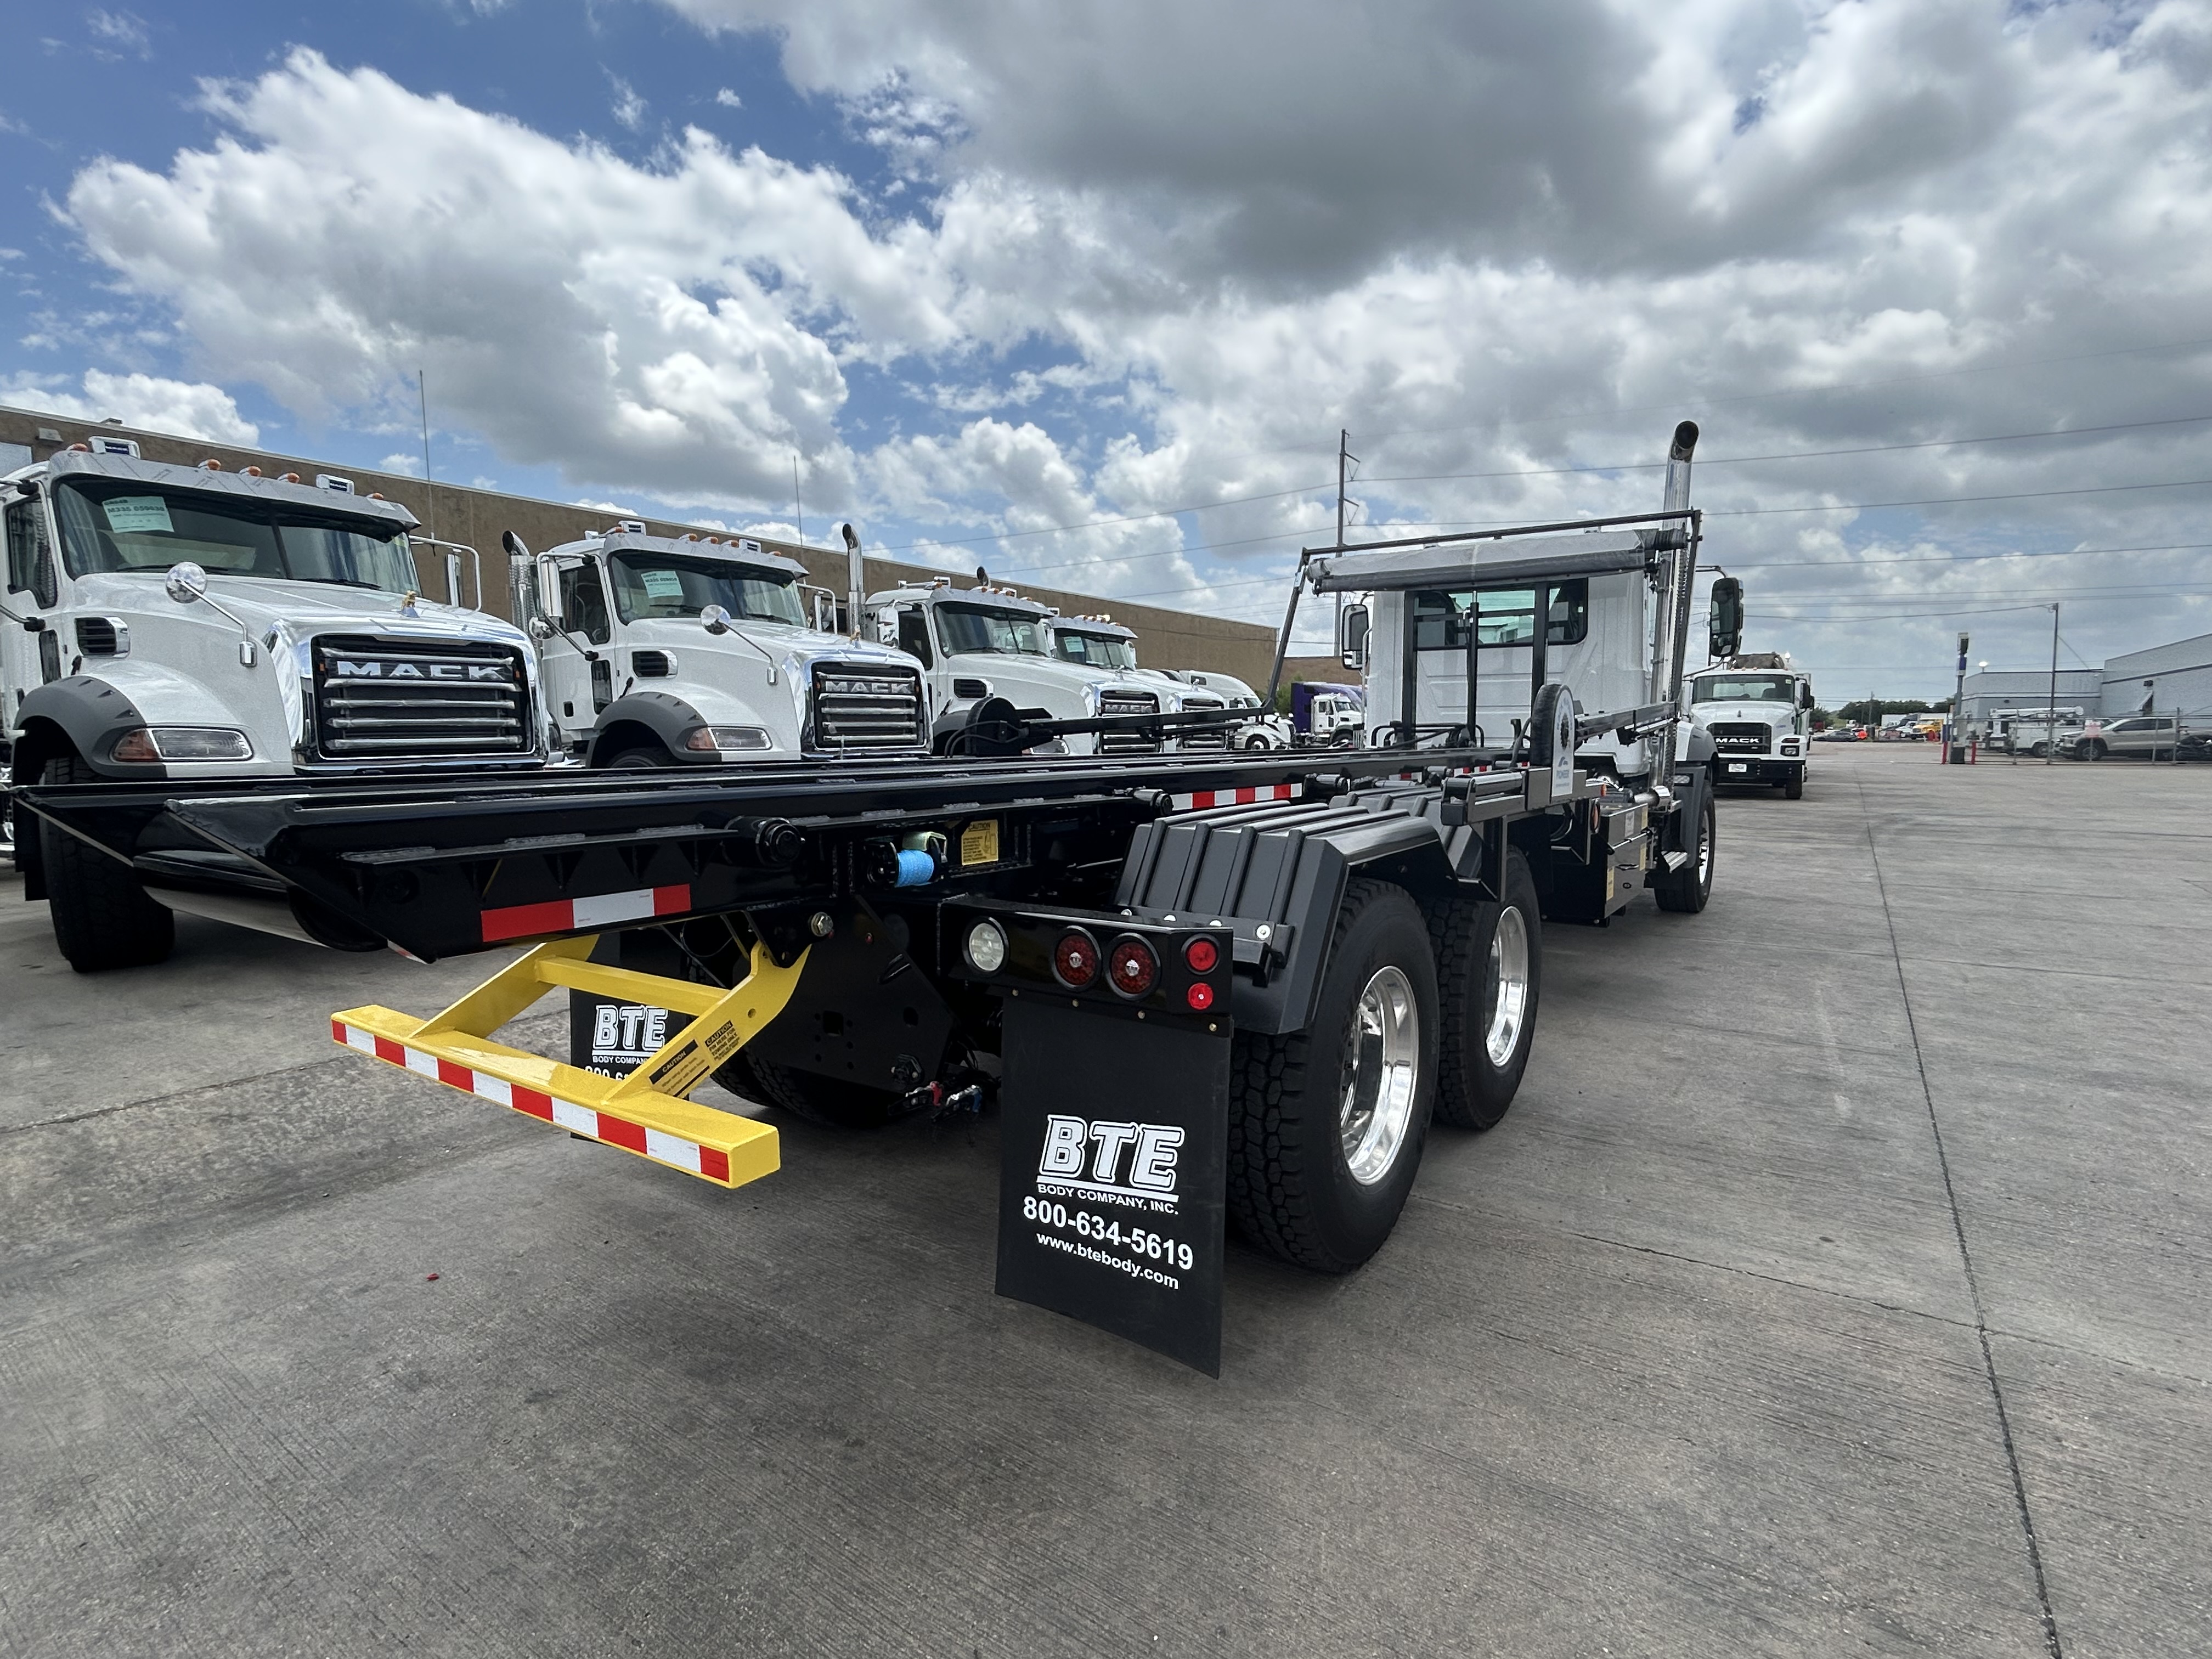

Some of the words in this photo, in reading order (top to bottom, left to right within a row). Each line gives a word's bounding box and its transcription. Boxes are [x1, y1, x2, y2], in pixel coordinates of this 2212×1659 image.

[337, 661, 506, 681] MACK
[825, 680, 912, 694] MACK
[1105, 704, 1153, 713] MACK
[593, 1005, 668, 1051] BTE
[707, 1021, 732, 1045] CAUTION
[662, 1051, 687, 1073] CAUTION
[1039, 1114, 1185, 1192] BTE
[1037, 1184, 1074, 1198] BODY
[1077, 1189, 1148, 1211] COMPANY,
[1150, 1200, 1179, 1215] INC.
[1023, 1196, 1194, 1270] 800-634-5619
[1036, 1233, 1179, 1290] www.btebody.com
